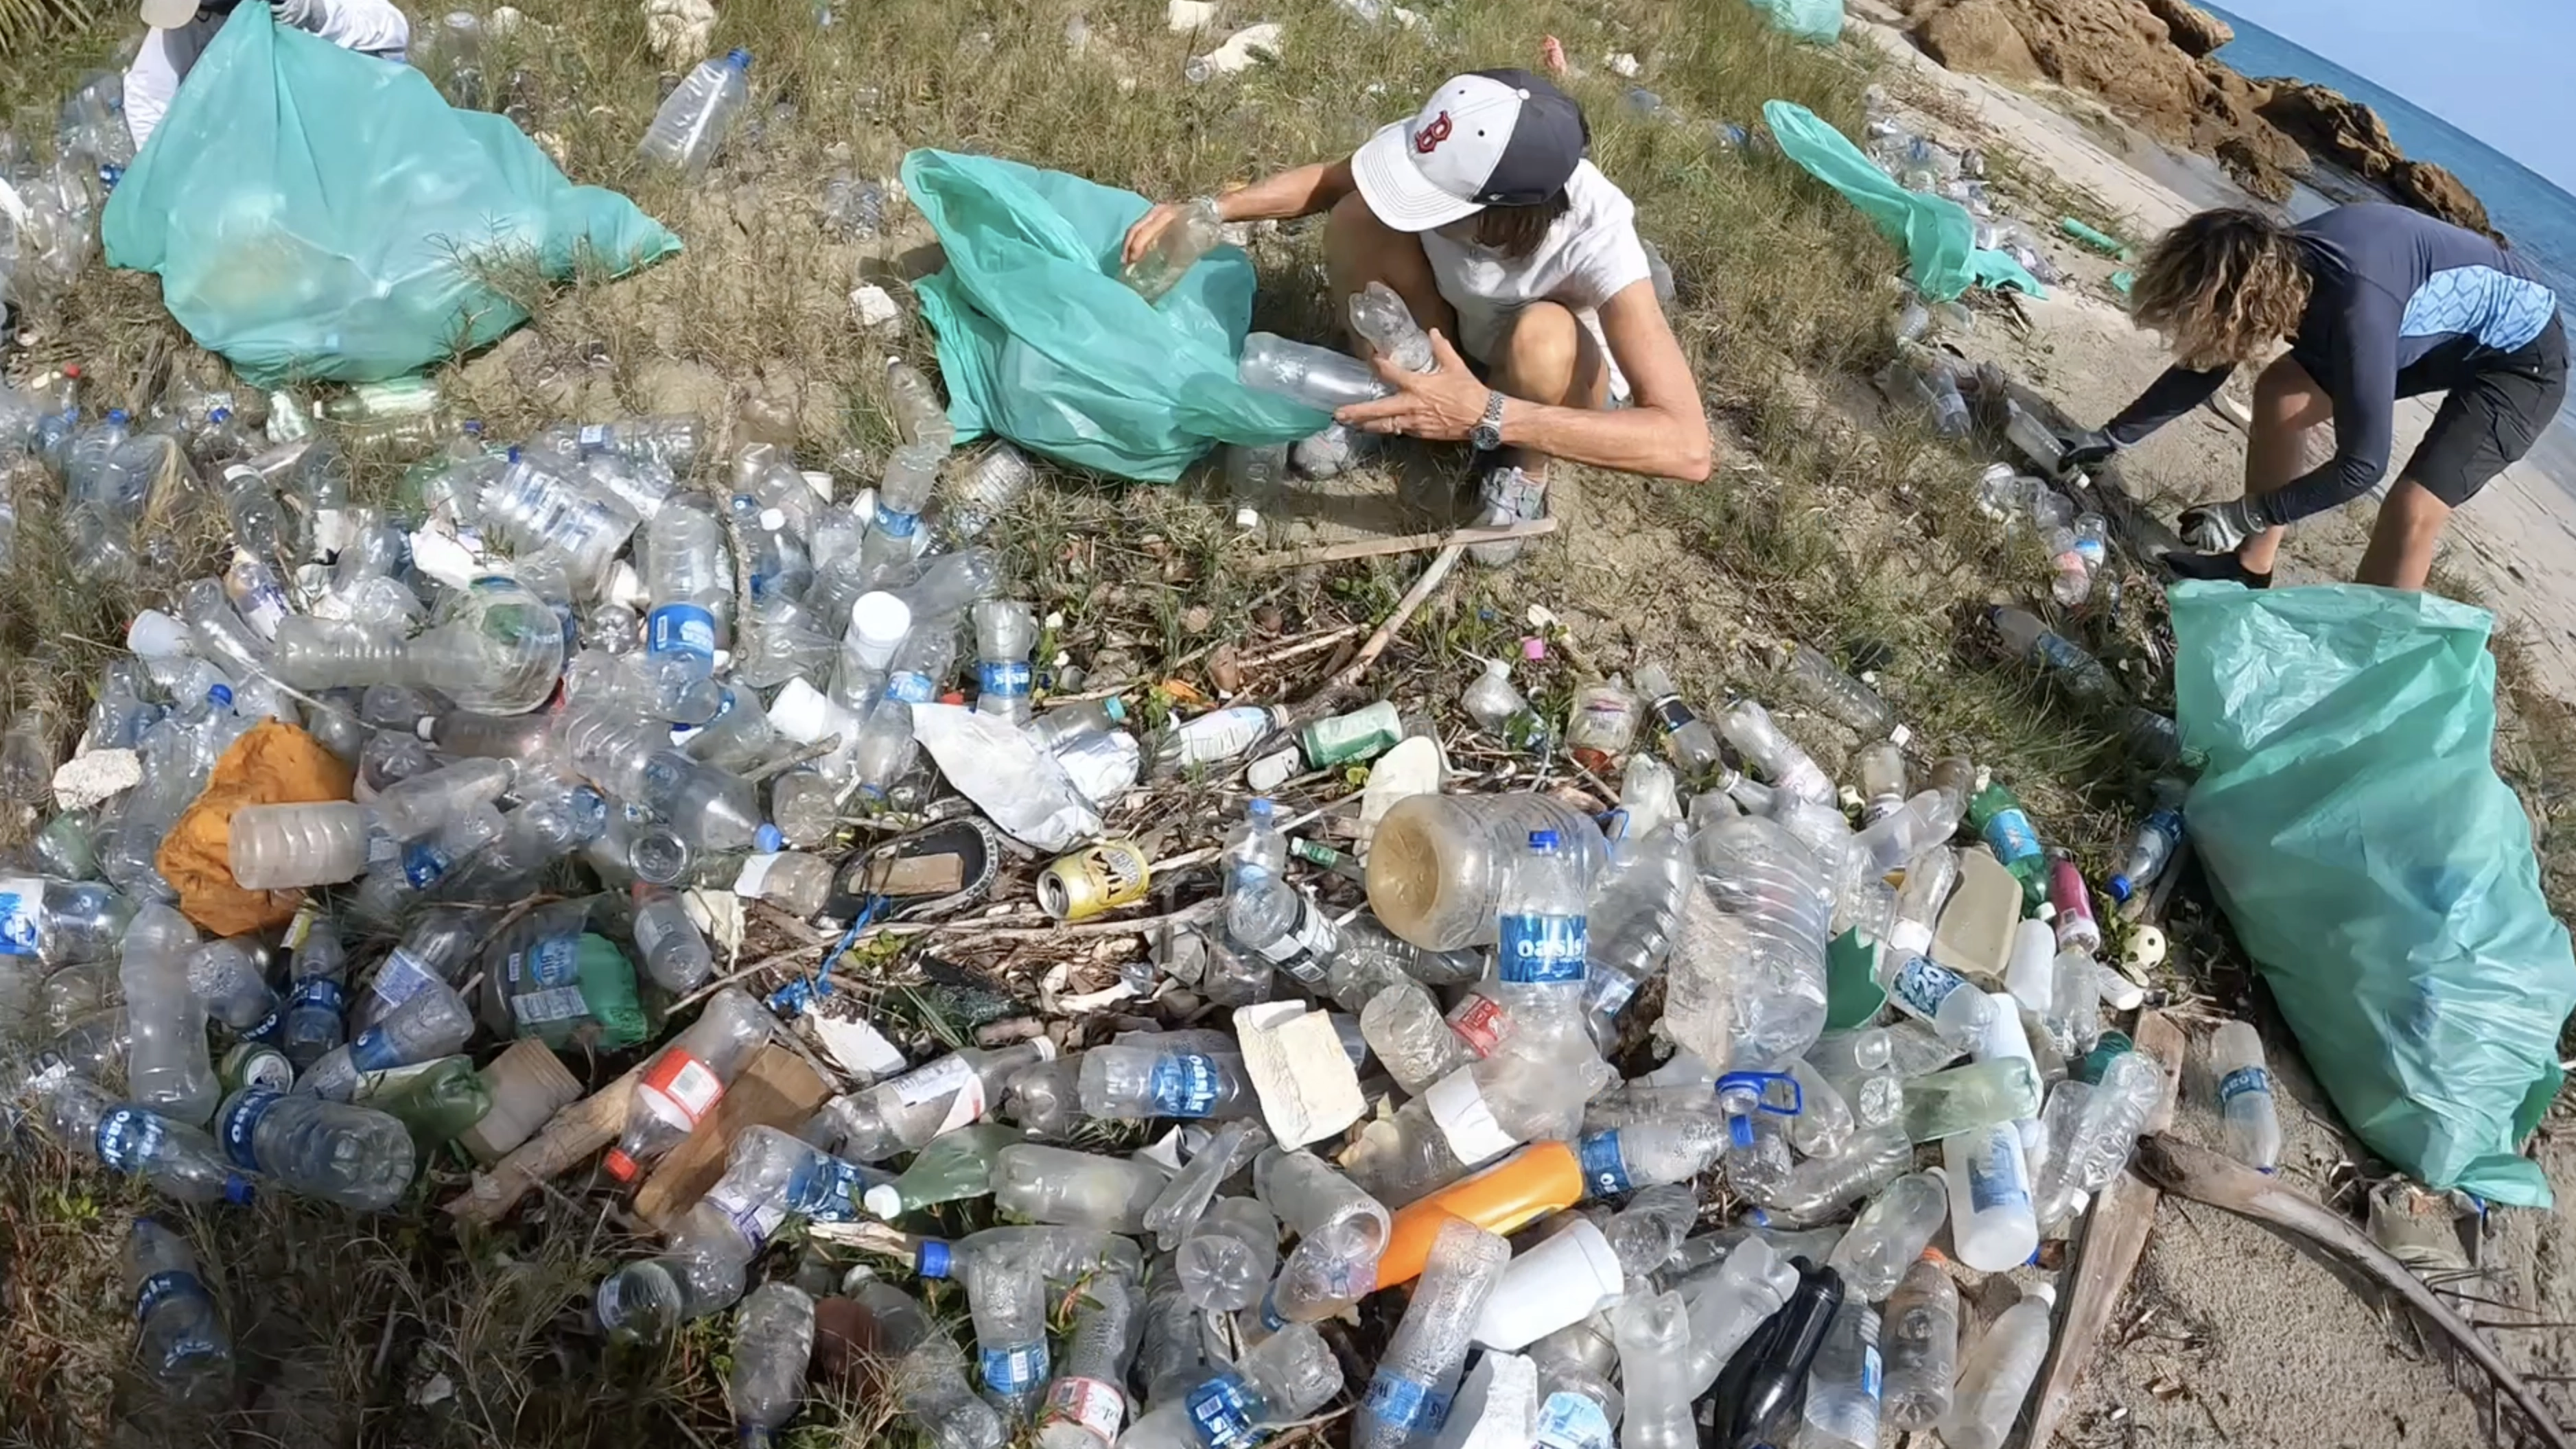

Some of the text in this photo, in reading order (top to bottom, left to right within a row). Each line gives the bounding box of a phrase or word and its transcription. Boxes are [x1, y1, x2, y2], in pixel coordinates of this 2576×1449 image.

[1415, 110, 1452, 154] B
[1091, 851, 1123, 900] TIKA
[1517, 923, 1582, 958] oasis
[1189, 1055, 1215, 1113] oasis
